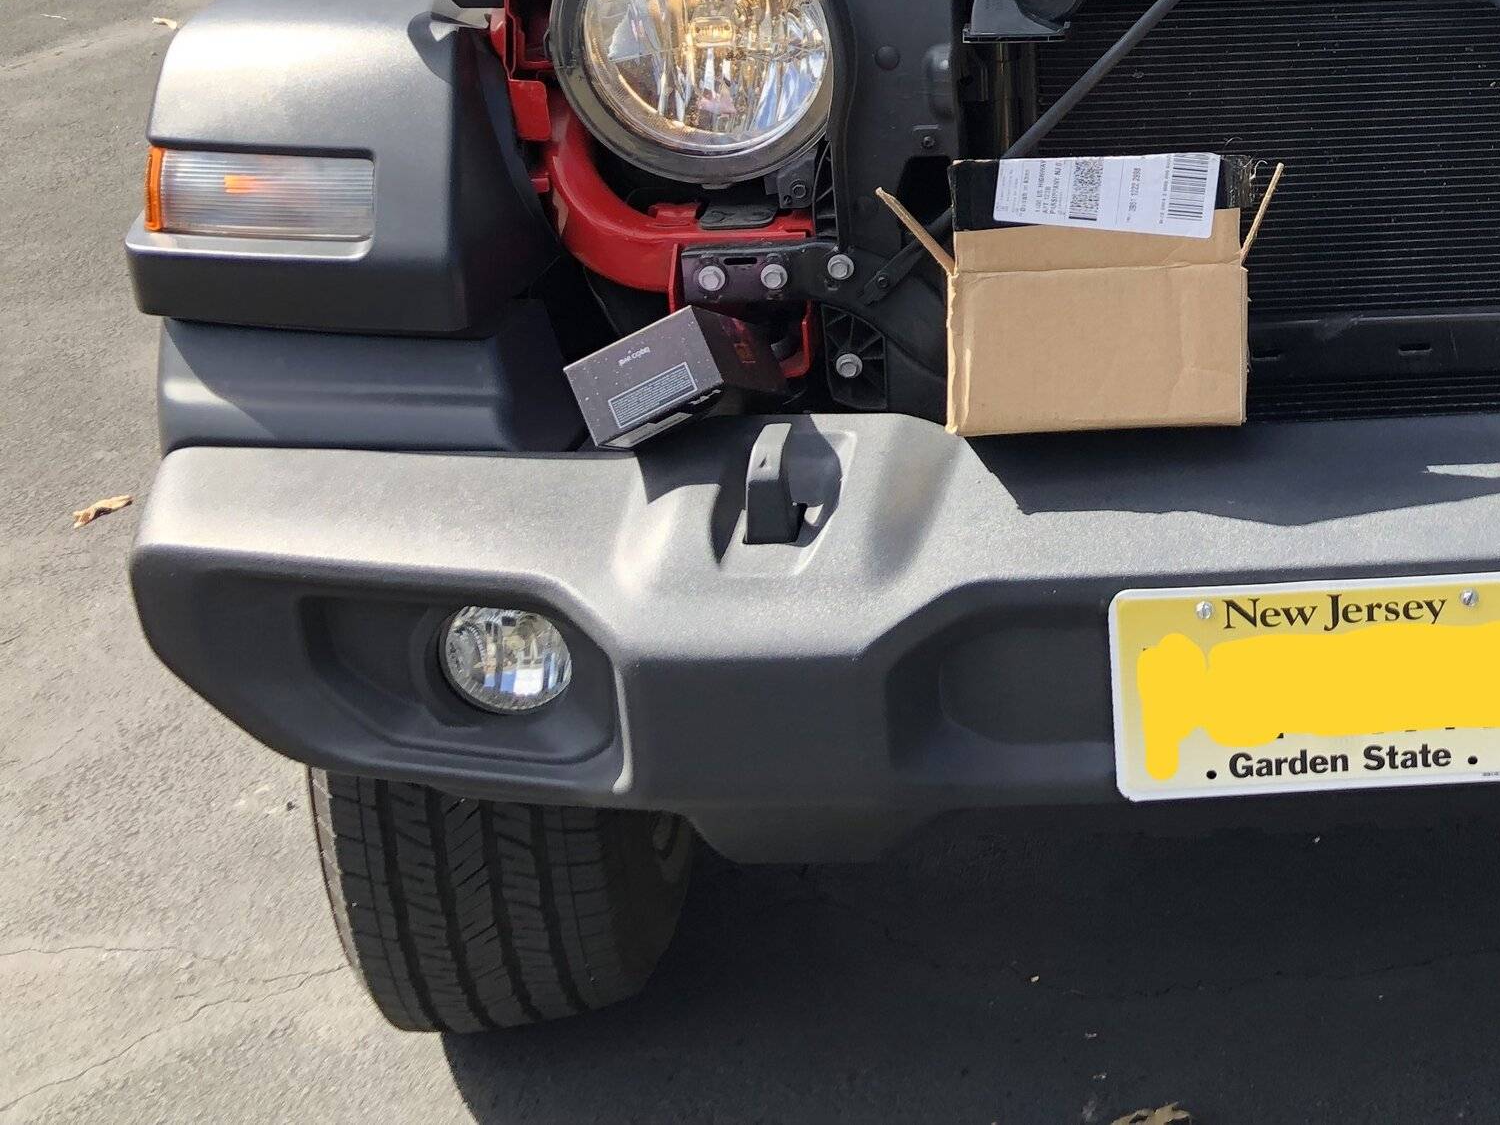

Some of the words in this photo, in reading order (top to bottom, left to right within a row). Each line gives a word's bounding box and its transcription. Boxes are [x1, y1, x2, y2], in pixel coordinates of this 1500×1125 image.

[1224, 597, 1318, 629] New
[1324, 593, 1448, 632] Jersey
[1229, 749, 1349, 779] Garden
[1363, 743, 1451, 770] State
